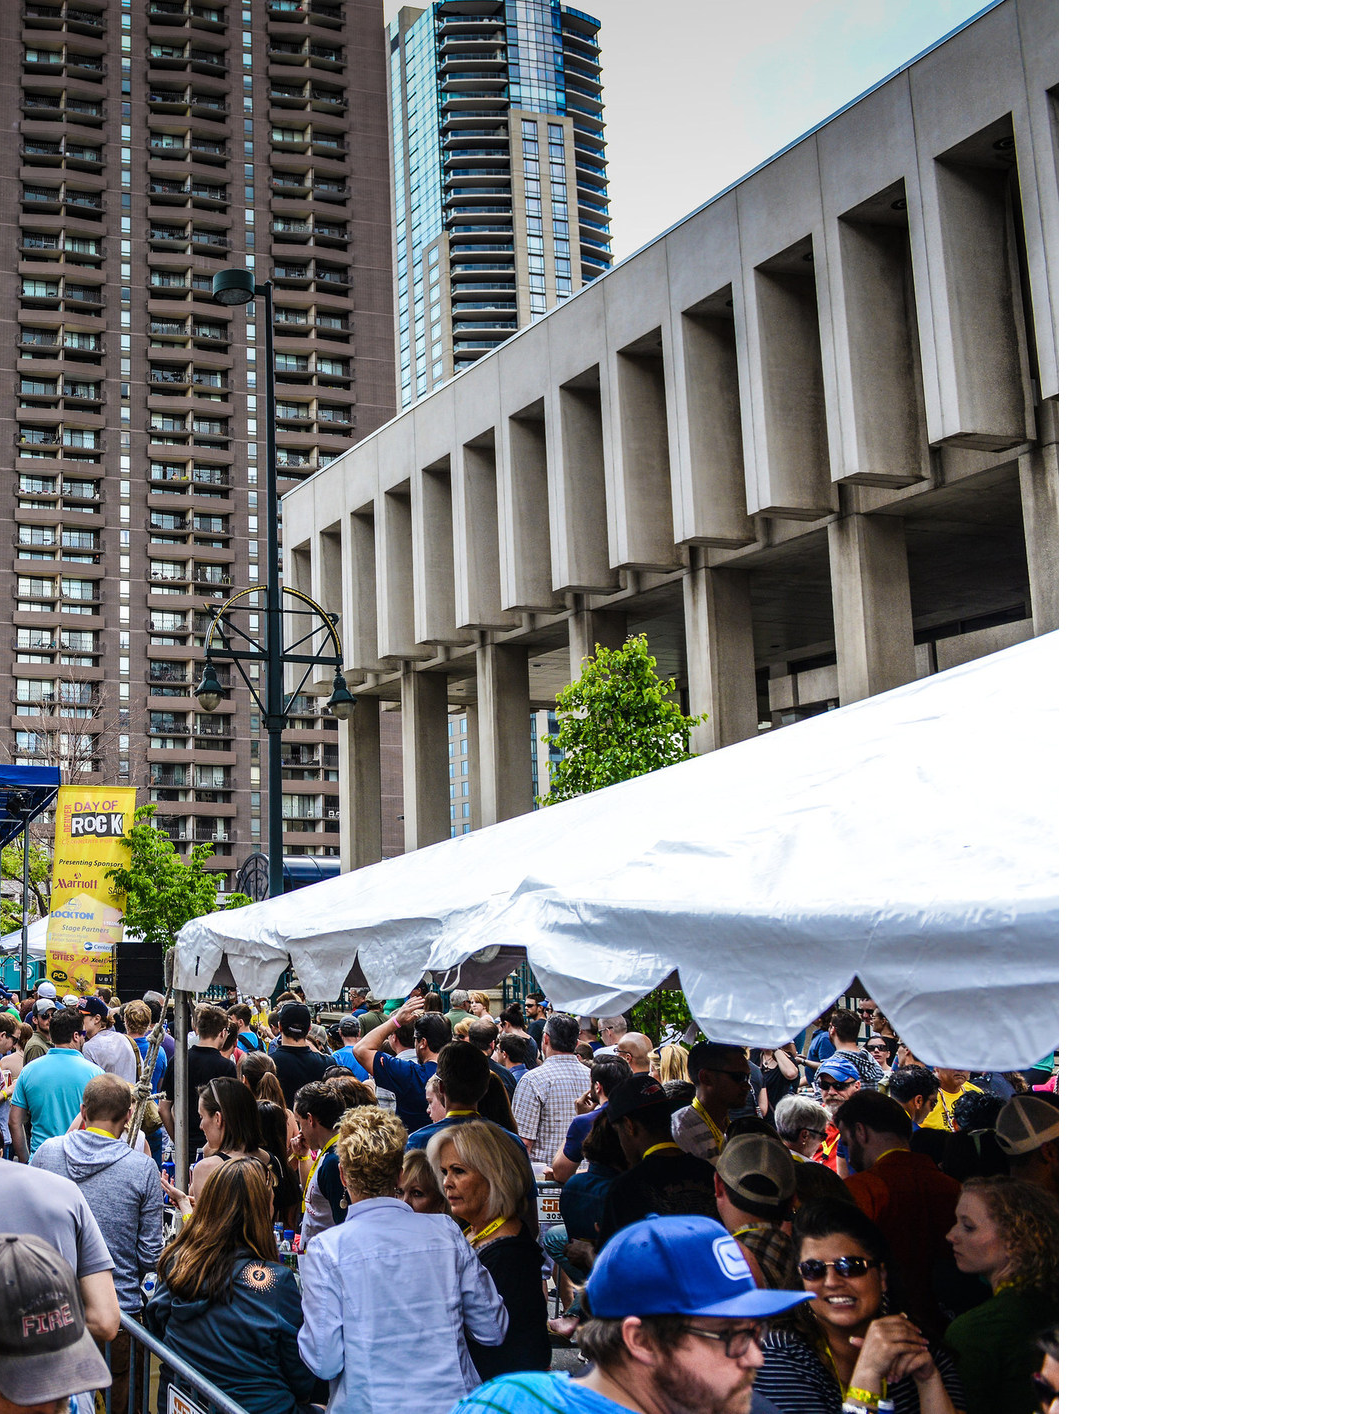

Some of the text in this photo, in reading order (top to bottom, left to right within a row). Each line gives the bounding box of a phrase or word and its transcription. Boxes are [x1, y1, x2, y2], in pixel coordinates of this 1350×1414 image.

[74, 800, 119, 812] DAY OF
[71, 814, 123, 834] ROCK
[58, 859, 124, 868] Presenting Sponsors
[54, 878, 98, 890] Marriott
[51, 910, 95, 920] LOCKTON
[62, 924, 110, 934] Stage Partners
[52, 952, 75, 961] CITIES
[22, 1303, 75, 1338] FIRE
